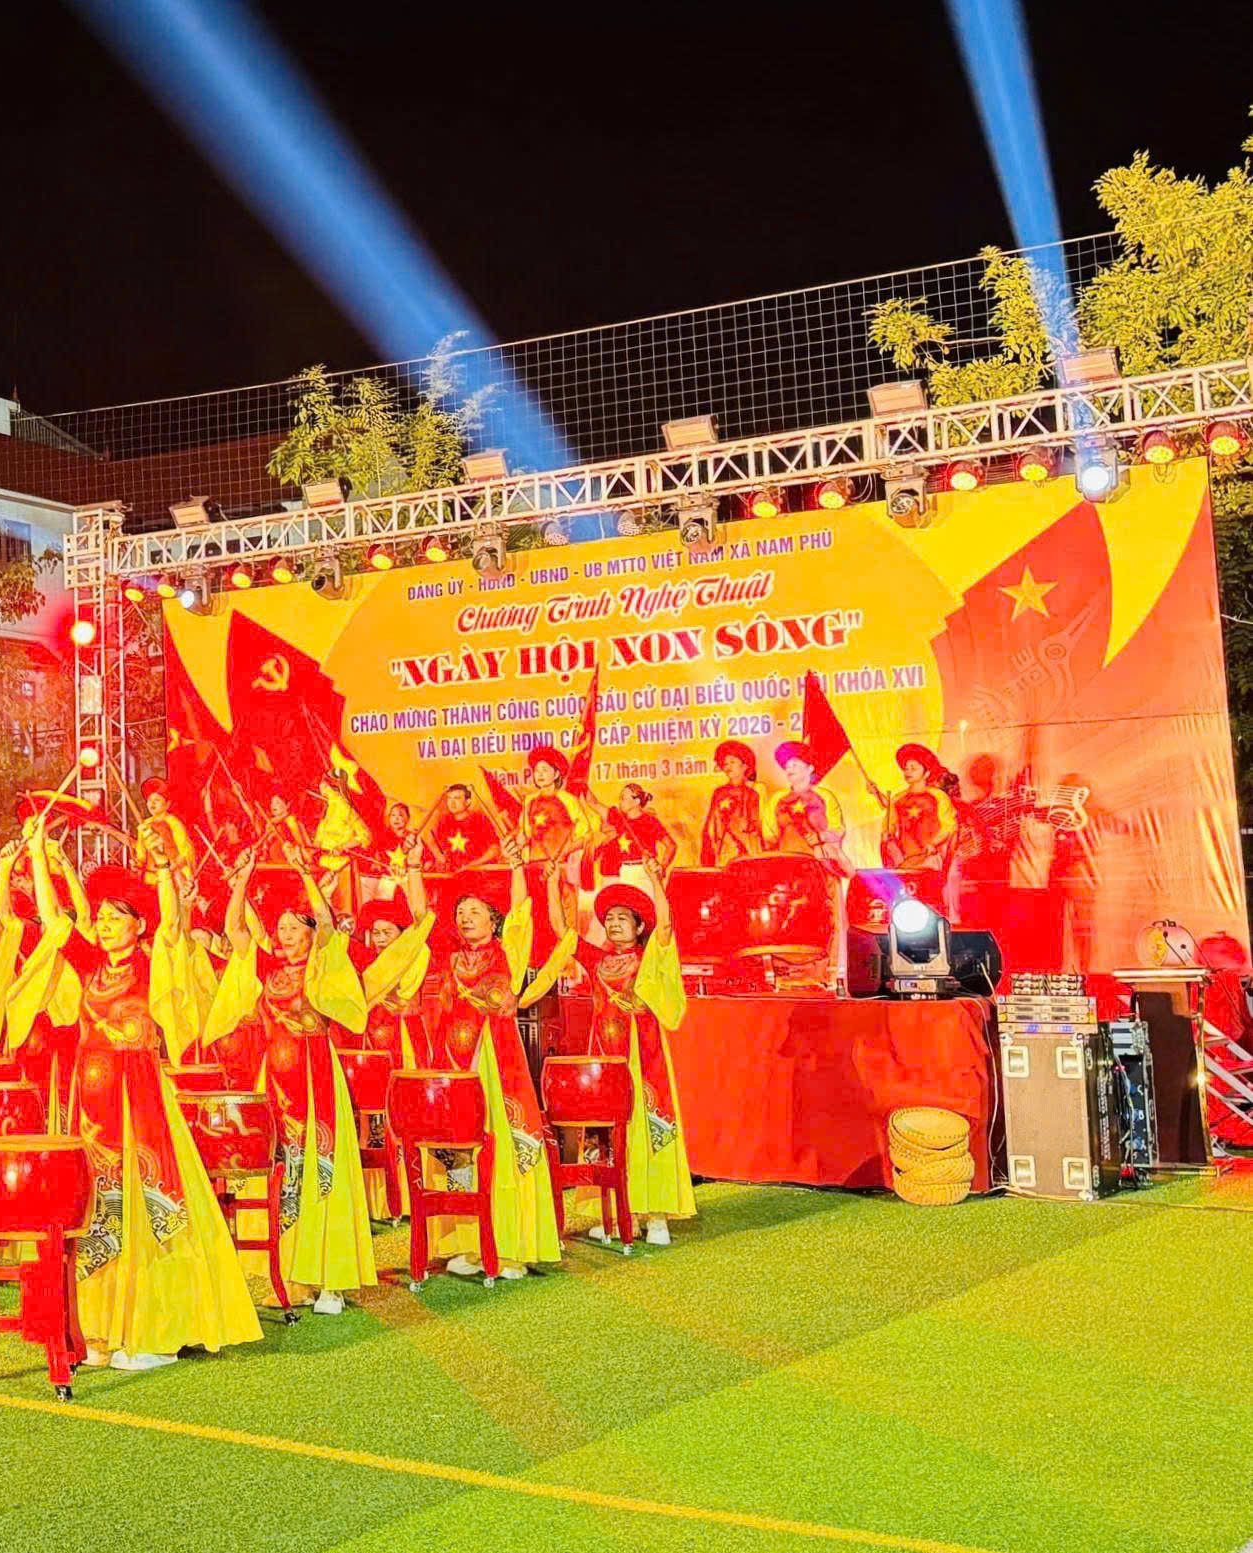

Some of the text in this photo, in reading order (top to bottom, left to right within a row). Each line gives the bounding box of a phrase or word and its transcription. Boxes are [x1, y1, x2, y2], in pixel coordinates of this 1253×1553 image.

[530, 567, 569, 585] UBND
[584, 563, 603, 578] UB
[607, 556, 647, 576] MTTQ
[652, 550, 683, 571] VIỆT
[688, 545, 724, 565] NAM
[756, 536, 793, 556] NAM
[457, 572, 772, 633] Chương Trình Nghệ Thuật
[391, 612, 861, 687] "NGÀY HỘI NON SÔNG"
[351, 710, 388, 733] CHÀO
[393, 706, 437, 730] MỪNG
[442, 702, 492, 725] THÀNH
[497, 698, 539, 721] CÔNG
[545, 692, 587, 719] CUỘC
[633, 683, 657, 710] CỬ
[661, 686, 690, 711] ĐẠI
[696, 675, 735, 705] BIỂU
[741, 671, 791, 702] QUỐC
[834, 665, 886, 693] KHÓA
[892, 665, 924, 689] XVI
[417, 736, 437, 759] VÀ
[441, 737, 466, 760] ĐẠI
[471, 727, 506, 755] BIỂU
[598, 718, 631, 745] CẤP
[636, 717, 694, 745] NHIỆM
[727, 714, 771, 737] 2026
[595, 762, 611, 780] 17
[617, 760, 657, 779] tháng
[662, 759, 671, 776] 3
[675, 757, 708, 776] năm
